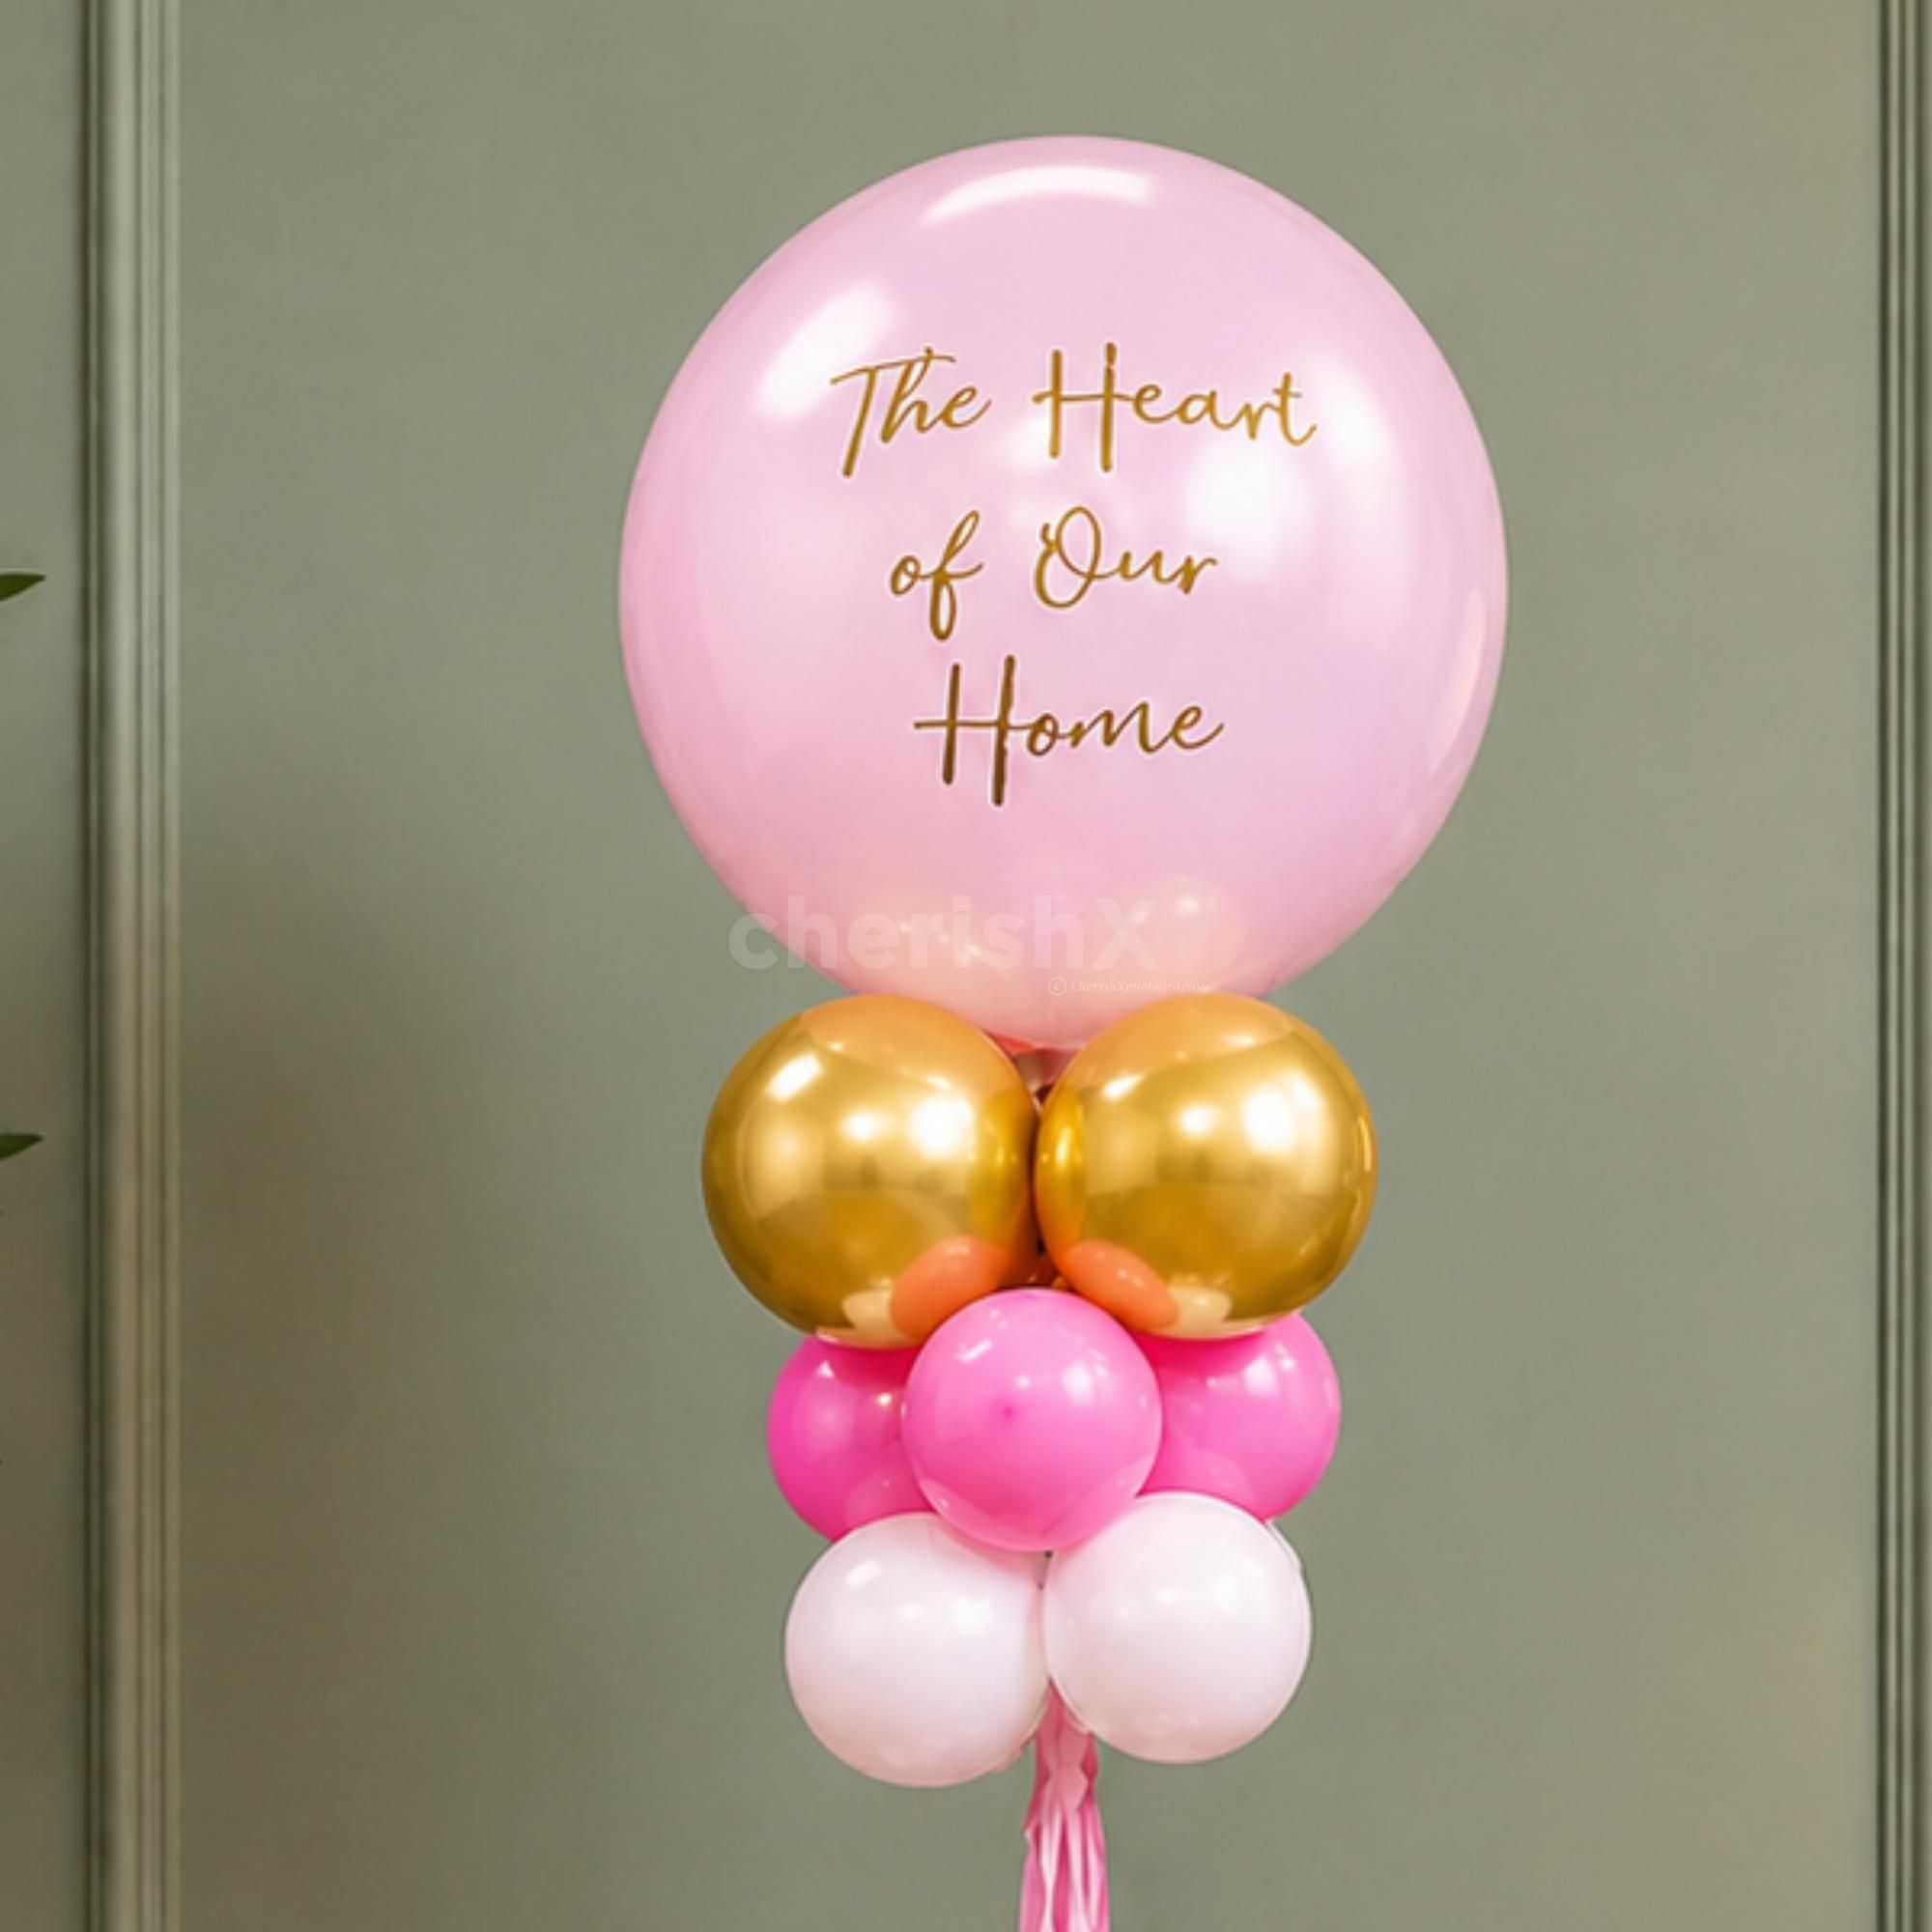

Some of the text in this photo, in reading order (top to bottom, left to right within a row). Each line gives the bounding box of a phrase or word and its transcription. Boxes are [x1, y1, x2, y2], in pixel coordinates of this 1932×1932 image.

[831, 342, 1318, 477] The Heart
[890, 506, 1218, 639] of Our
[913, 655, 1225, 807] Home
